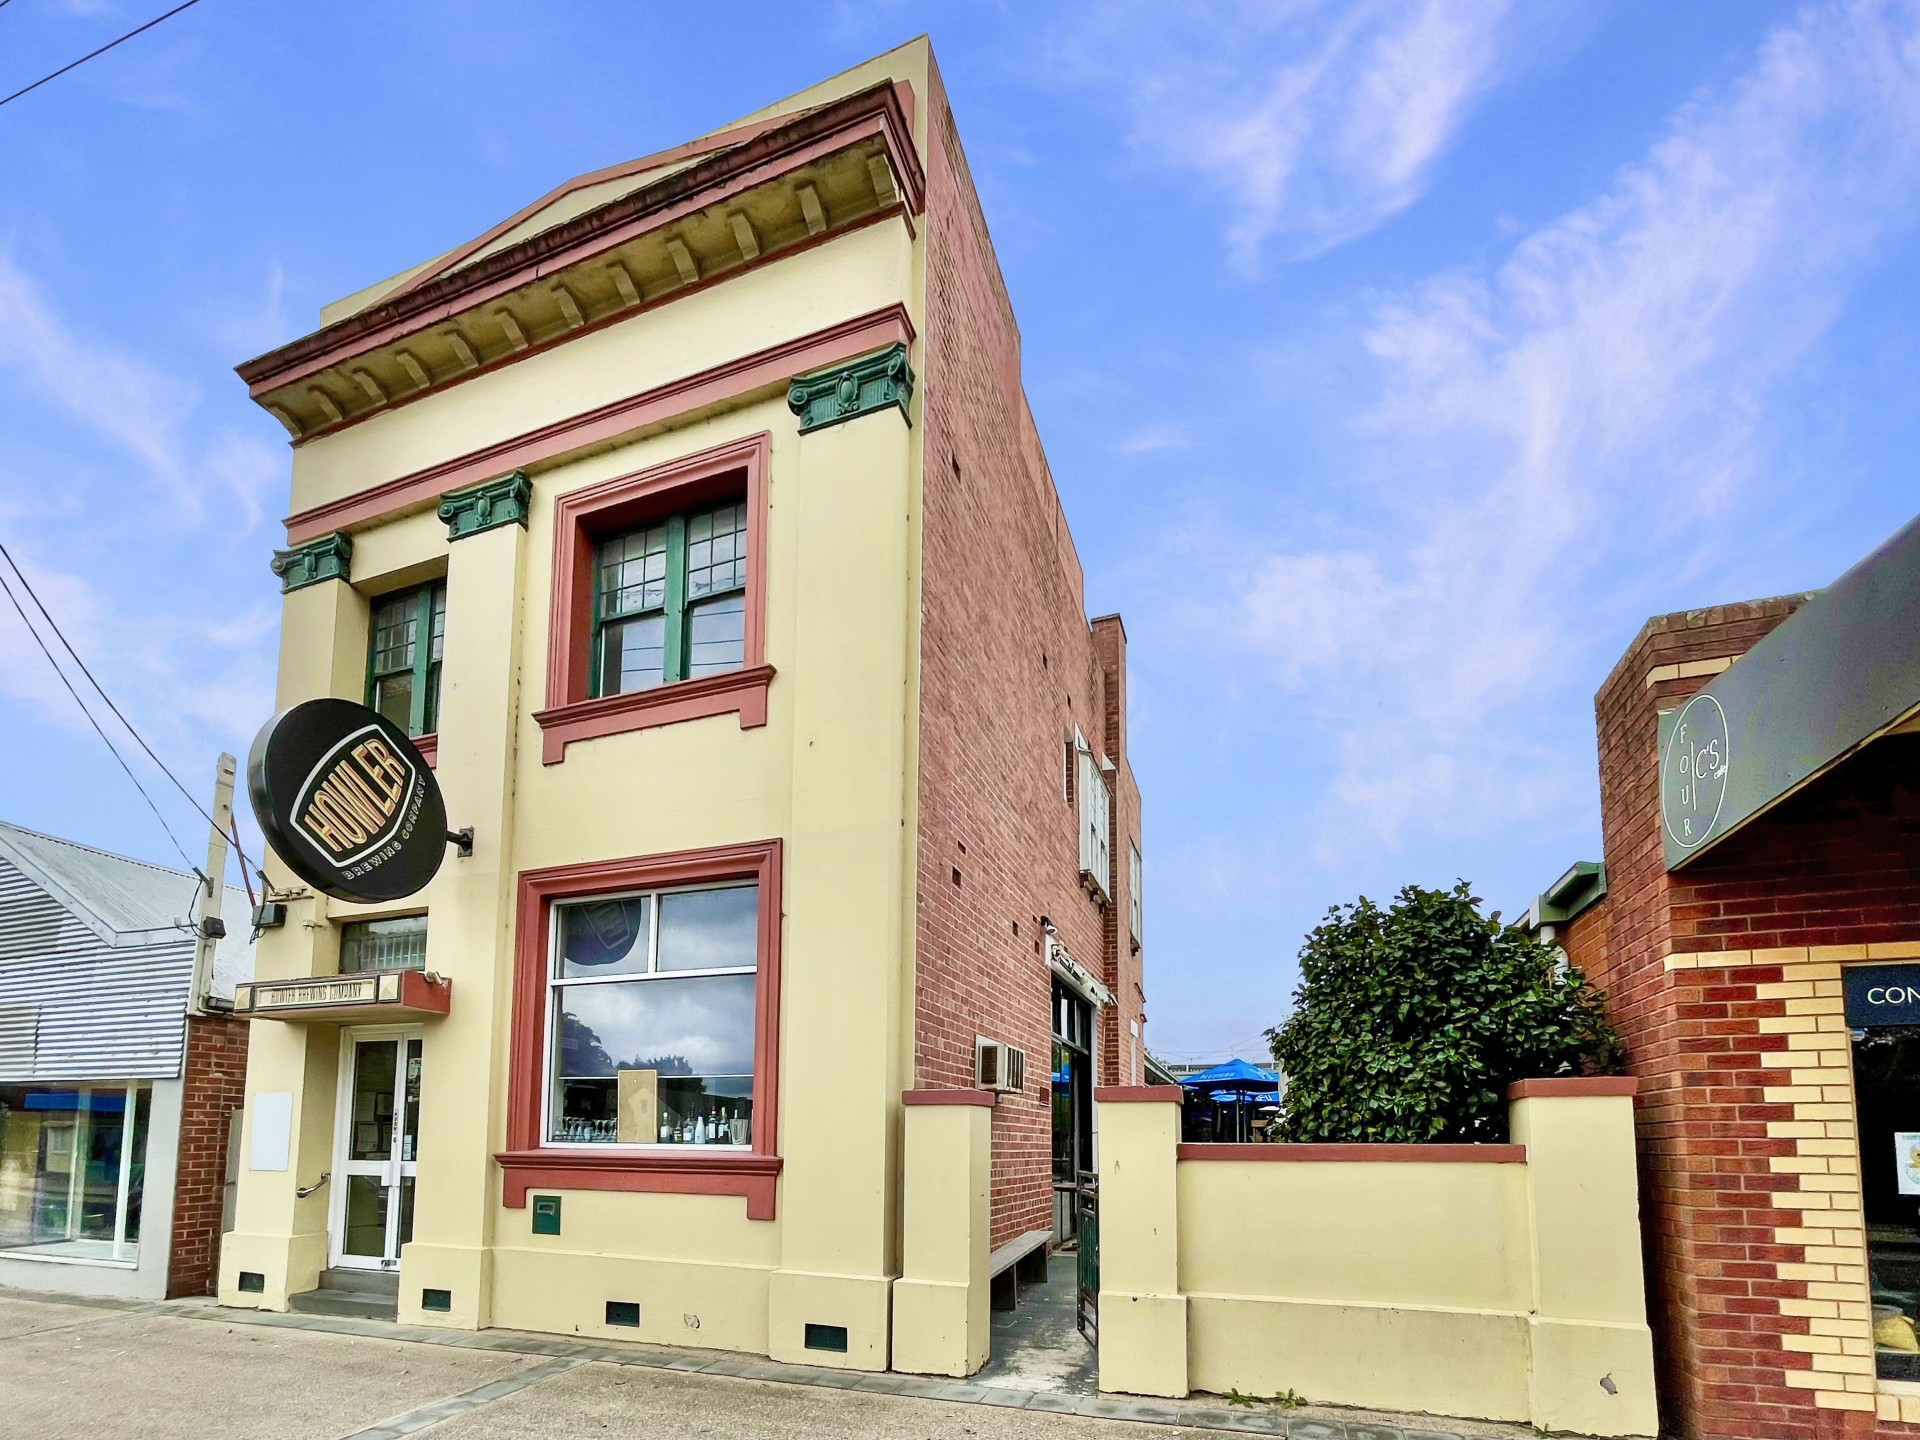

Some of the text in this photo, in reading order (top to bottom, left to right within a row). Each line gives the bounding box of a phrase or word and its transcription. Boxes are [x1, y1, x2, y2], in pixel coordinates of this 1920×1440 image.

[304, 738, 407, 852] HOWLER
[341, 774, 426, 881] BREWING COMPANY
[1679, 723, 1692, 837] FOUR
[271, 982, 362, 1004] HOWLER BREWING COMPANY
